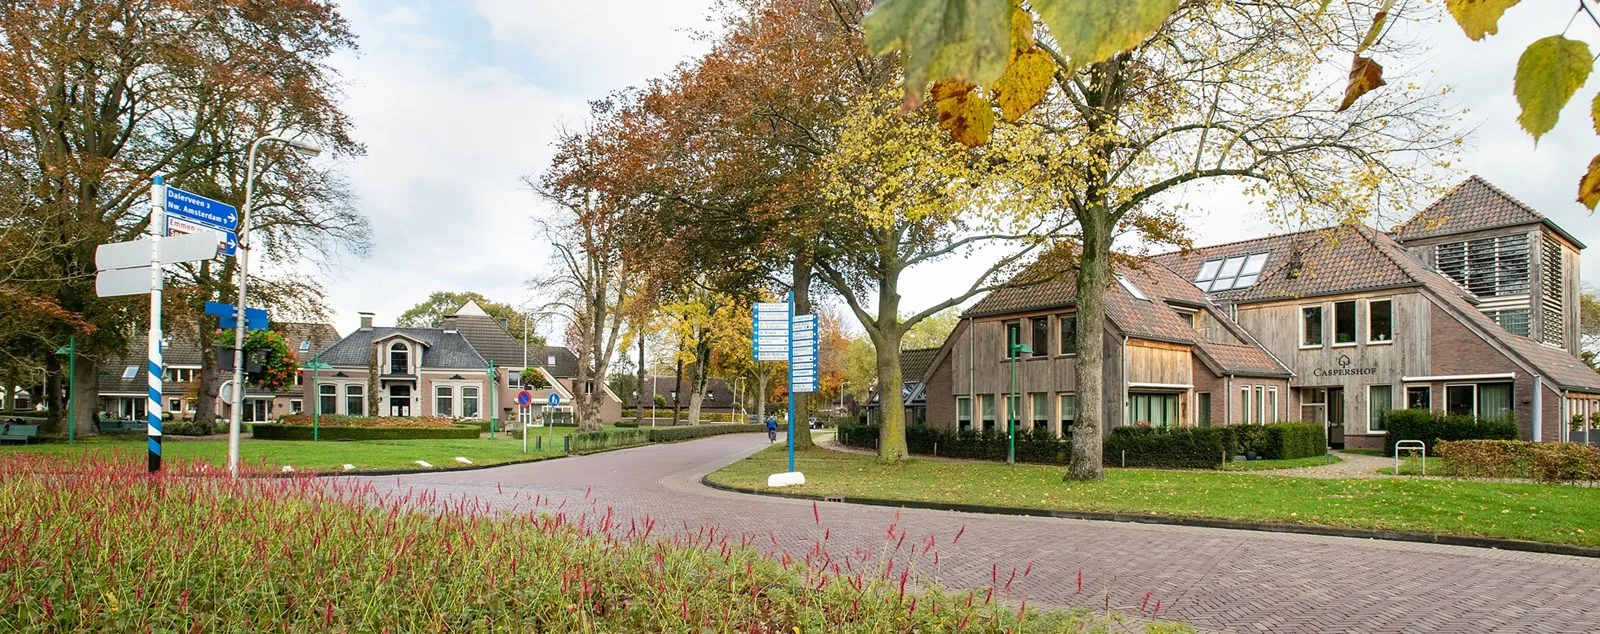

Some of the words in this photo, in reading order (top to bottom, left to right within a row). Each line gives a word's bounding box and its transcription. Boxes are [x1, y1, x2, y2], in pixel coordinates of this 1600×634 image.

[168, 190, 205, 207] Dalerveen
[168, 201, 182, 211] Nw.
[183, 206, 222, 222] Amsterdam
[170, 219, 195, 230] Emmen
[1313, 368, 1376, 377] CASPERSHOF
